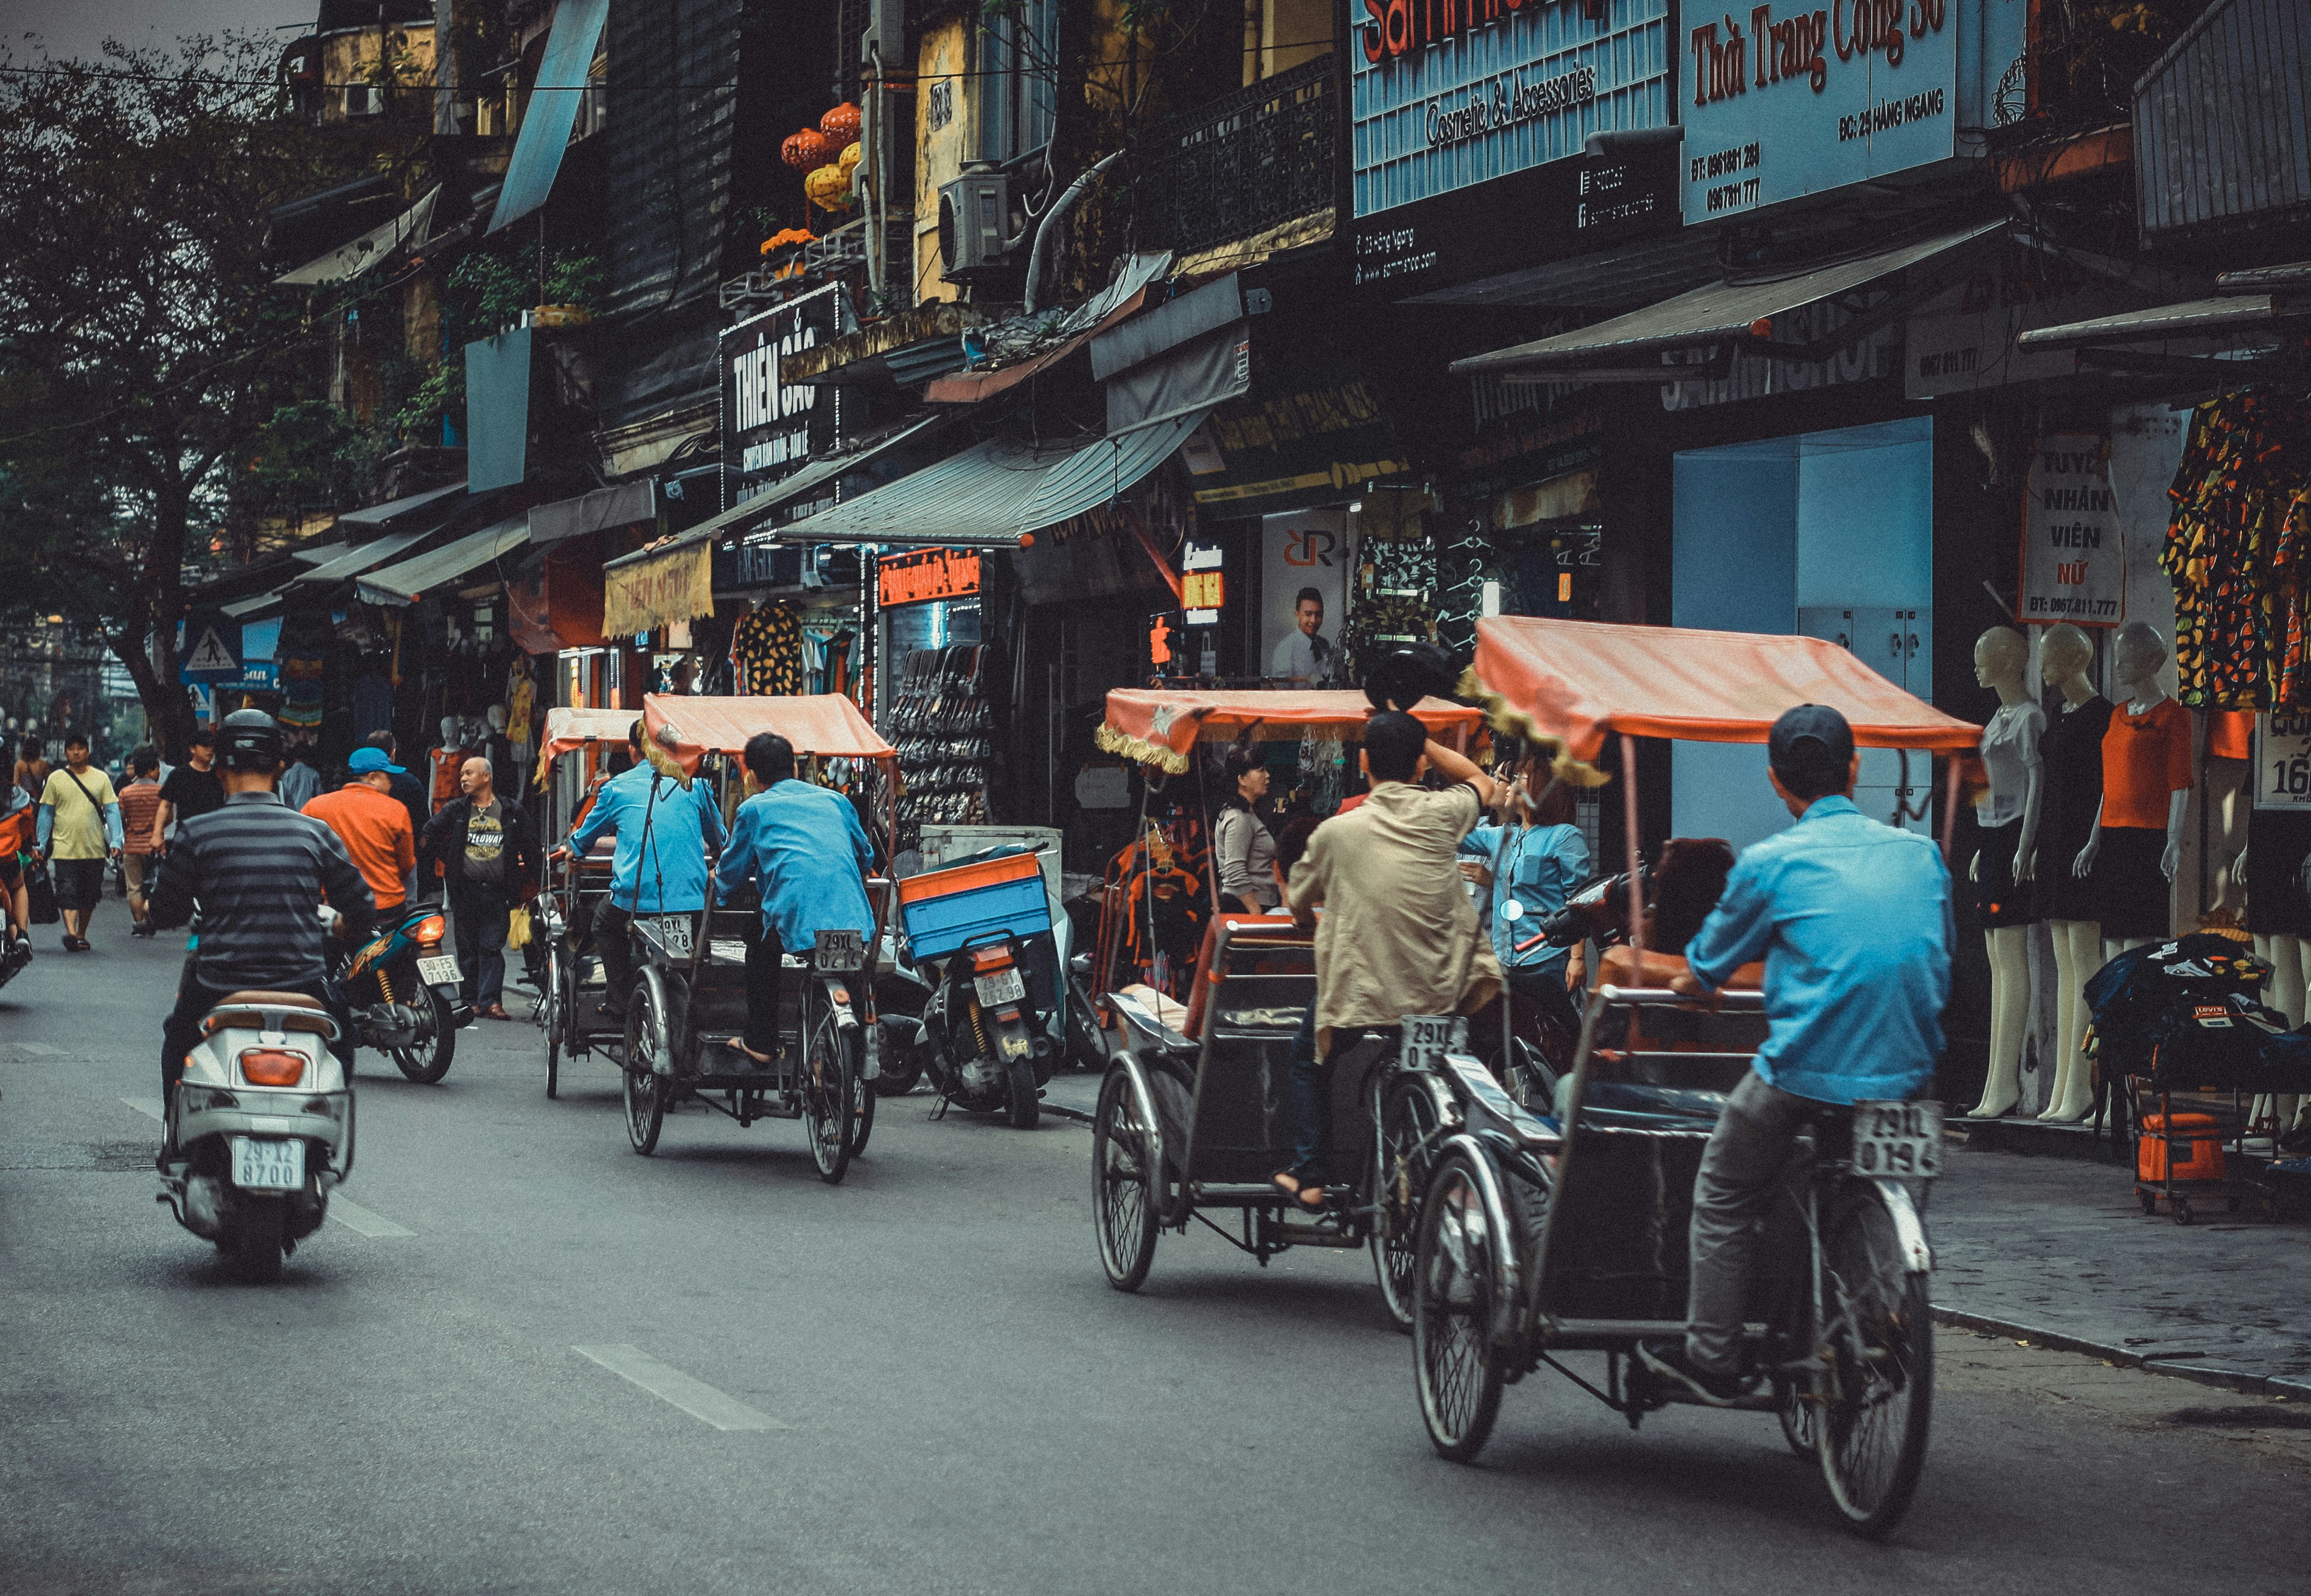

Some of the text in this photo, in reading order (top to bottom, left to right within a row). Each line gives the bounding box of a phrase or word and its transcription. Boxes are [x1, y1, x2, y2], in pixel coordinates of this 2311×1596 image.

[1691, 13, 1746, 105] Thời
[1751, 3, 1827, 93] Trang
[1426, 61, 1595, 147] Cosmetic & Accessories
[1859, 108, 1872, 137] 25
[1872, 97, 1903, 132] HÀNG
[1904, 88, 1944, 124] NGANG
[1743, 177, 1760, 203] 777
[1961, 347, 1978, 372] 777
[734, 332, 778, 433] THIÊN
[2044, 485, 2110, 512] NHÂN
[2051, 521, 2101, 549] VIÊN
[2057, 559, 2088, 585] NỮ
[2271, 759, 2311, 795] 16
[428, 969, 458, 983] 7136
